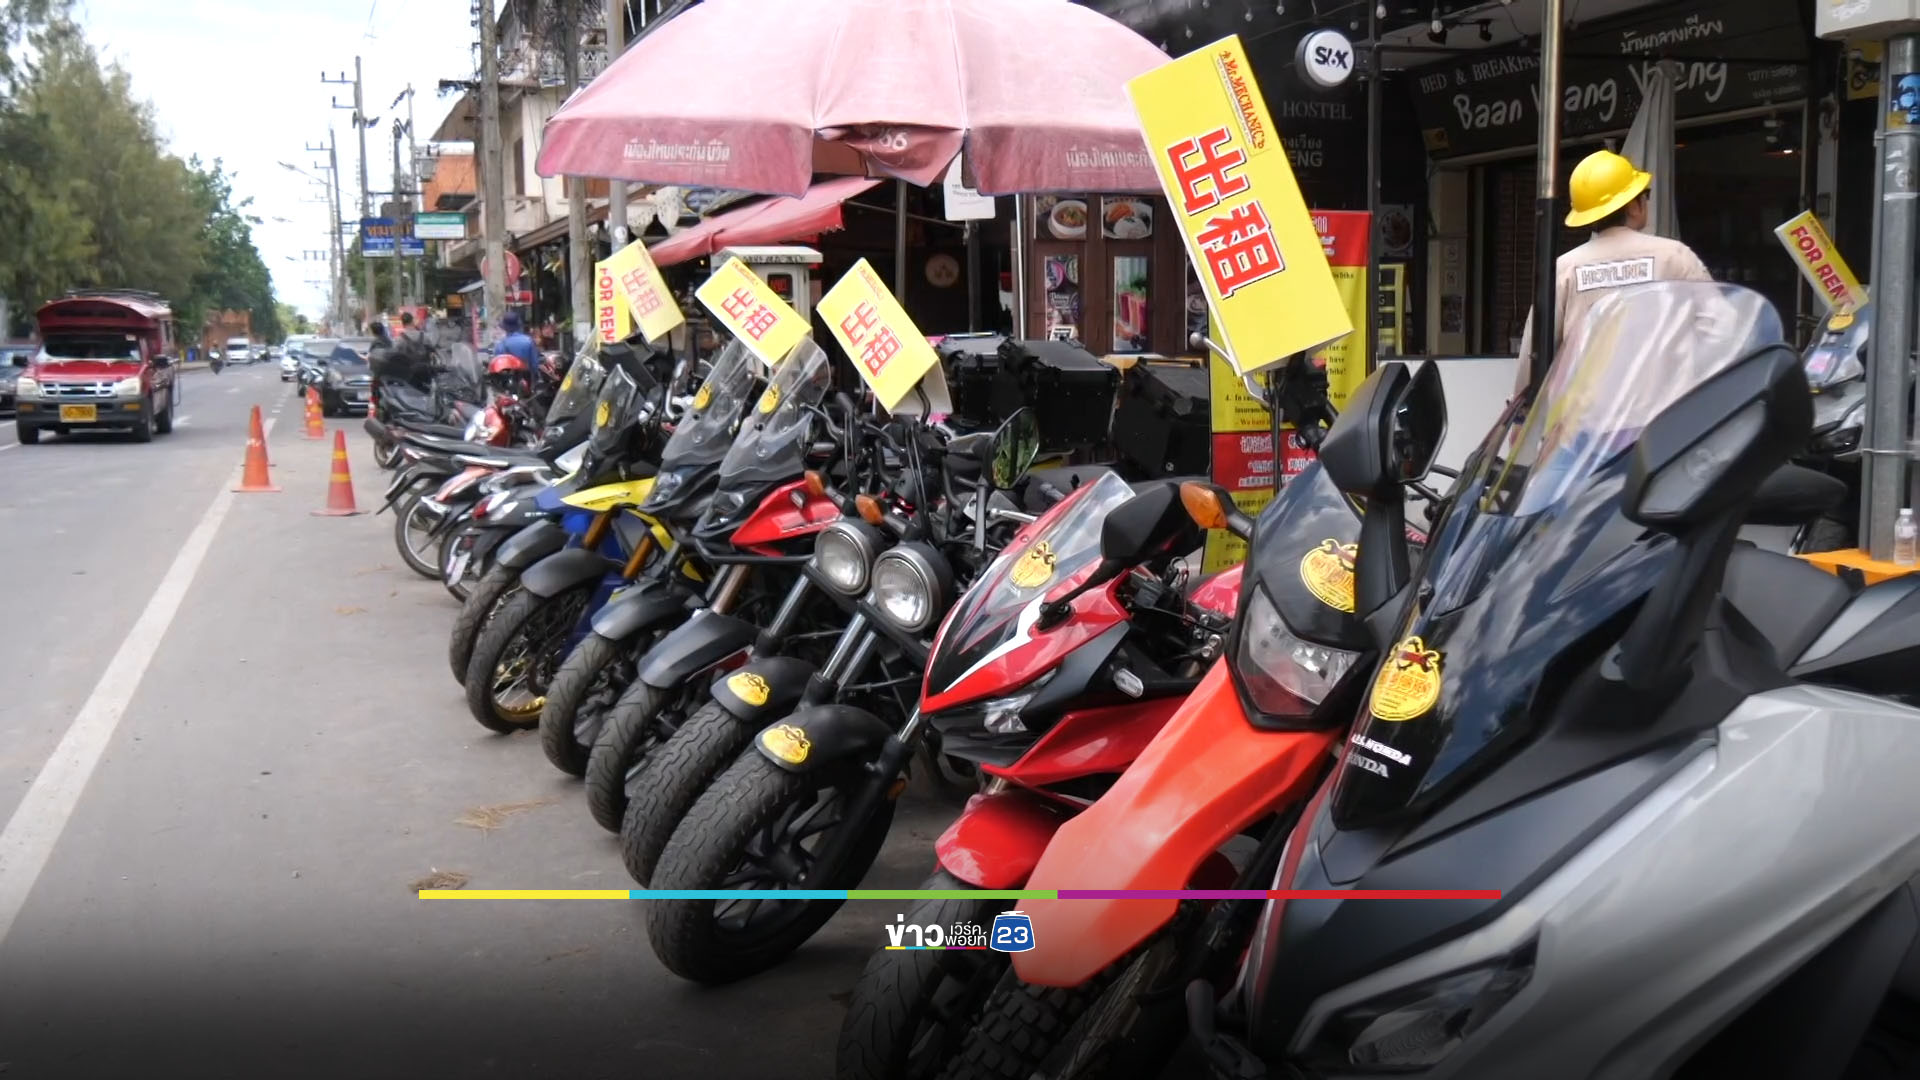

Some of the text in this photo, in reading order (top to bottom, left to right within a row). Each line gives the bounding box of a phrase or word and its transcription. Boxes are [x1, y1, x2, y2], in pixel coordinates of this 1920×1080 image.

[1419, 73, 1448, 94] BED
[1455, 68, 1467, 86] &
[1282, 101, 1353, 120] HOSTEL
[1453, 94, 1522, 130] Baan
[1790, 225, 1824, 265] FOR
[600, 306, 615, 341] REN
[721, 287, 781, 341] 出租
[840, 300, 903, 378] 出租
